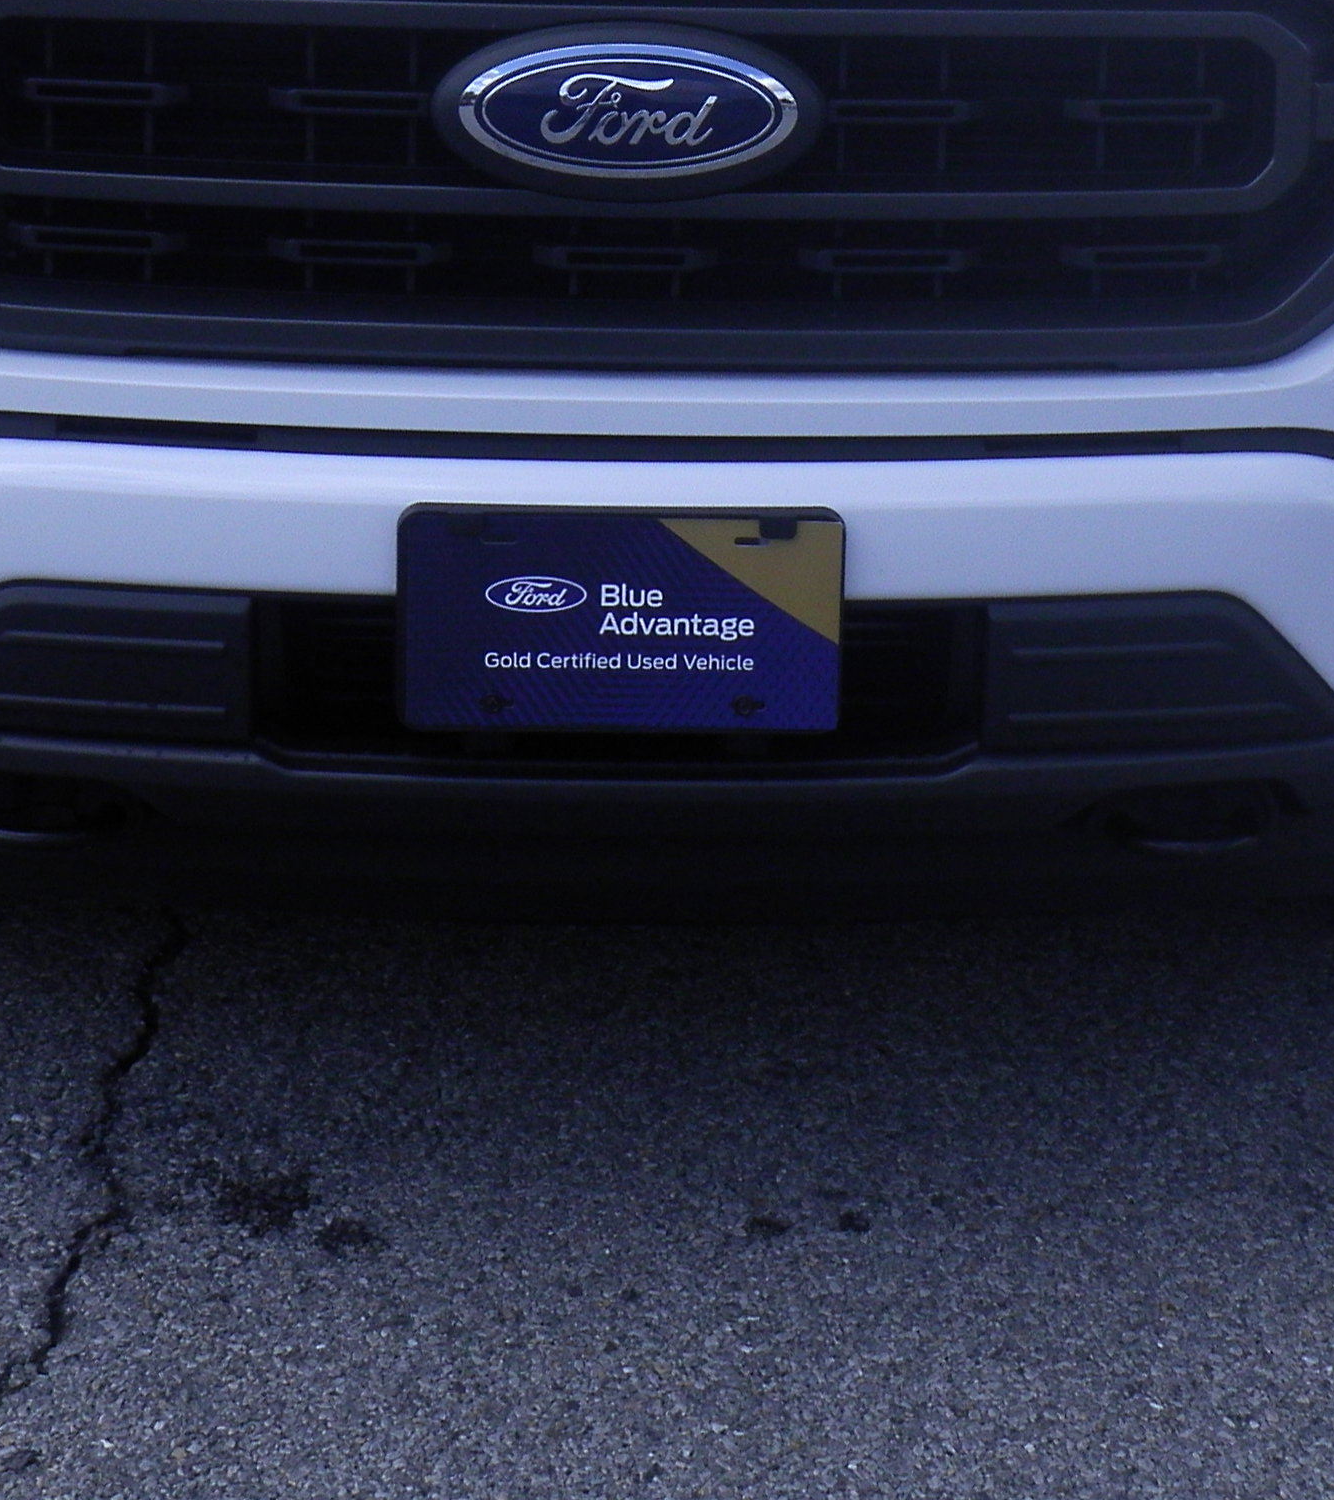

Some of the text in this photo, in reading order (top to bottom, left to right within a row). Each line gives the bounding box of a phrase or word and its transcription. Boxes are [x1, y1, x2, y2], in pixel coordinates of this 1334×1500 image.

[539, 73, 718, 145] Ford
[505, 582, 567, 606] Ford
[600, 583, 663, 607] Blue
[599, 612, 755, 641] Advantage
[484, 652, 755, 671] Gold Certified Used Vehicle
